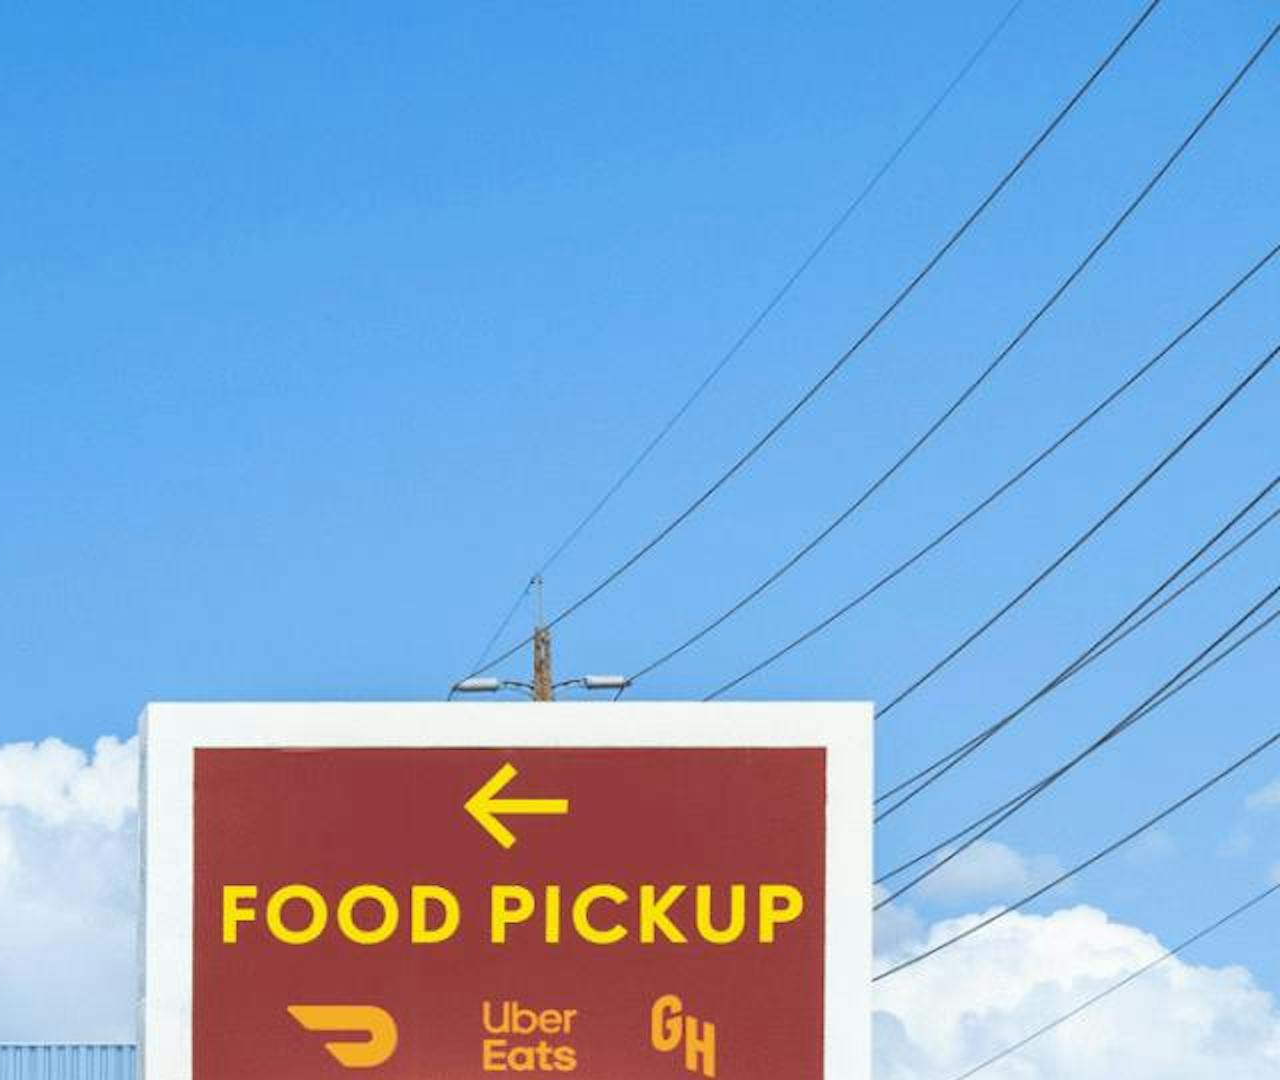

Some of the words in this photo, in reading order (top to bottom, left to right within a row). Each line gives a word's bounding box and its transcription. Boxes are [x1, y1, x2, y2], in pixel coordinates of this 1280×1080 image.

[222, 884, 461, 945] FOOD
[490, 884, 804, 944] PICKUP
[482, 1000, 578, 1035] Uber
[650, 993, 717, 1078] GH
[482, 1039, 578, 1072] Eats
